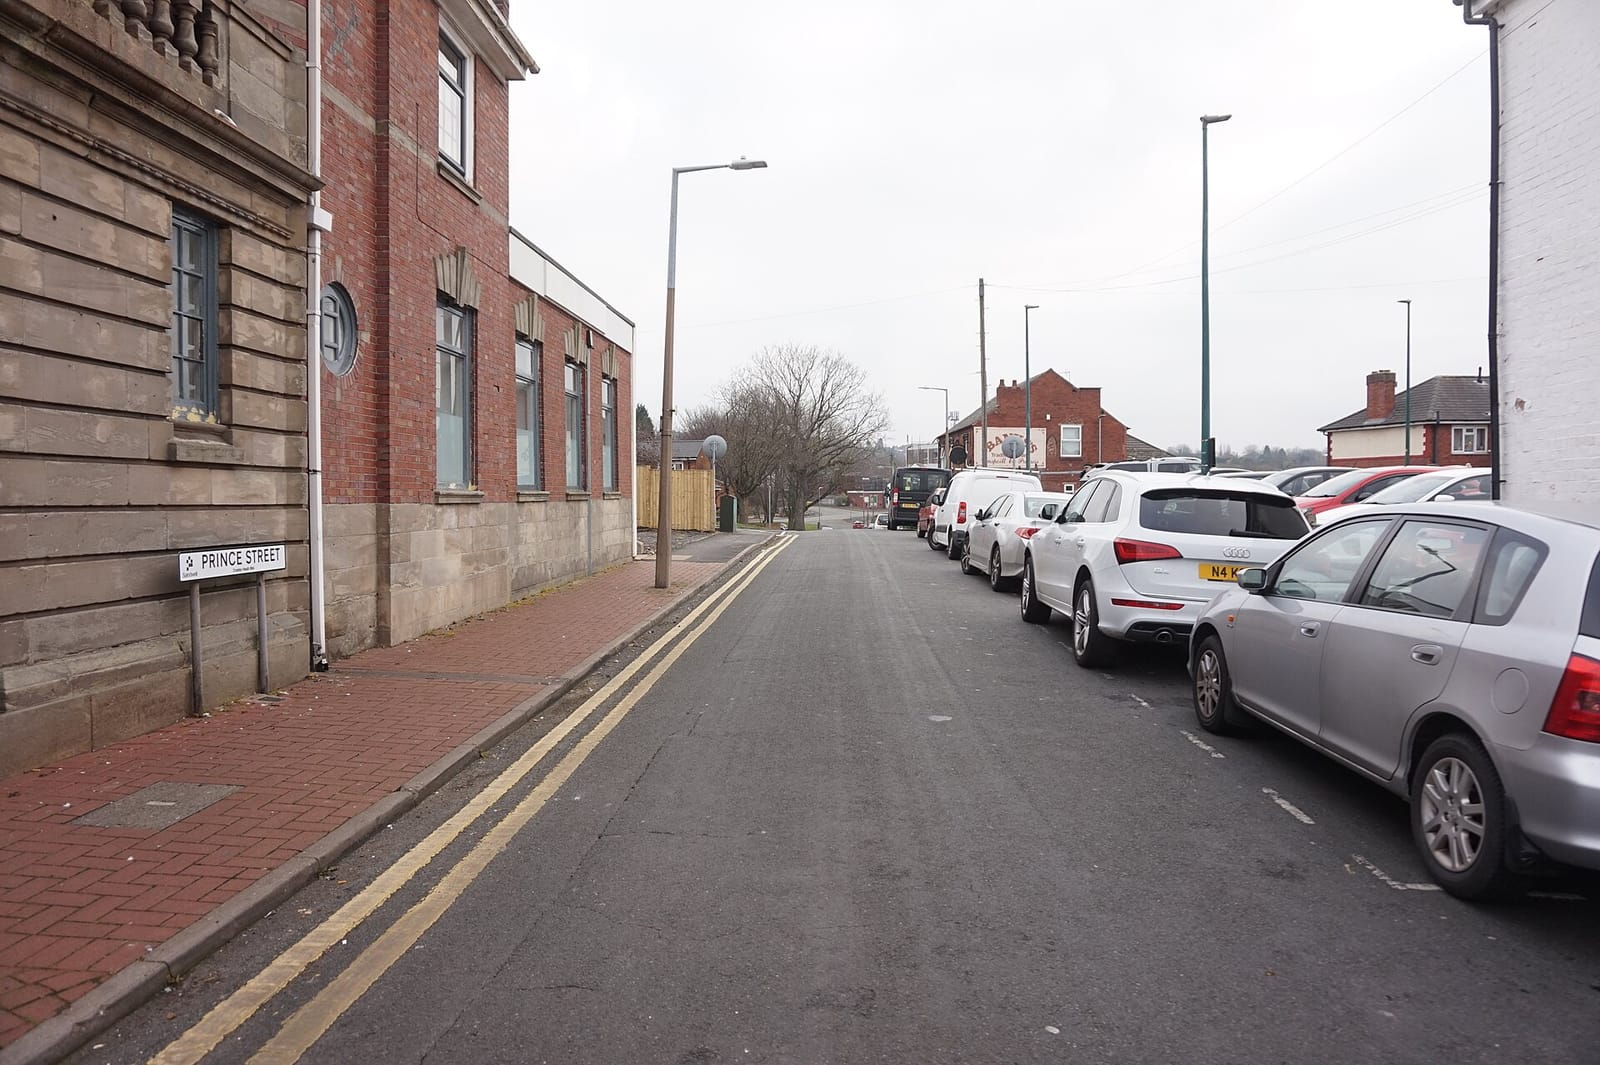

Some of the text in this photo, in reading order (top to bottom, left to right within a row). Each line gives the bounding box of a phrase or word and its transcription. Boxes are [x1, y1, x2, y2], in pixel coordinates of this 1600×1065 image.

[202, 548, 281, 569] PRINCE STREET
[1211, 566, 1228, 578] N4
